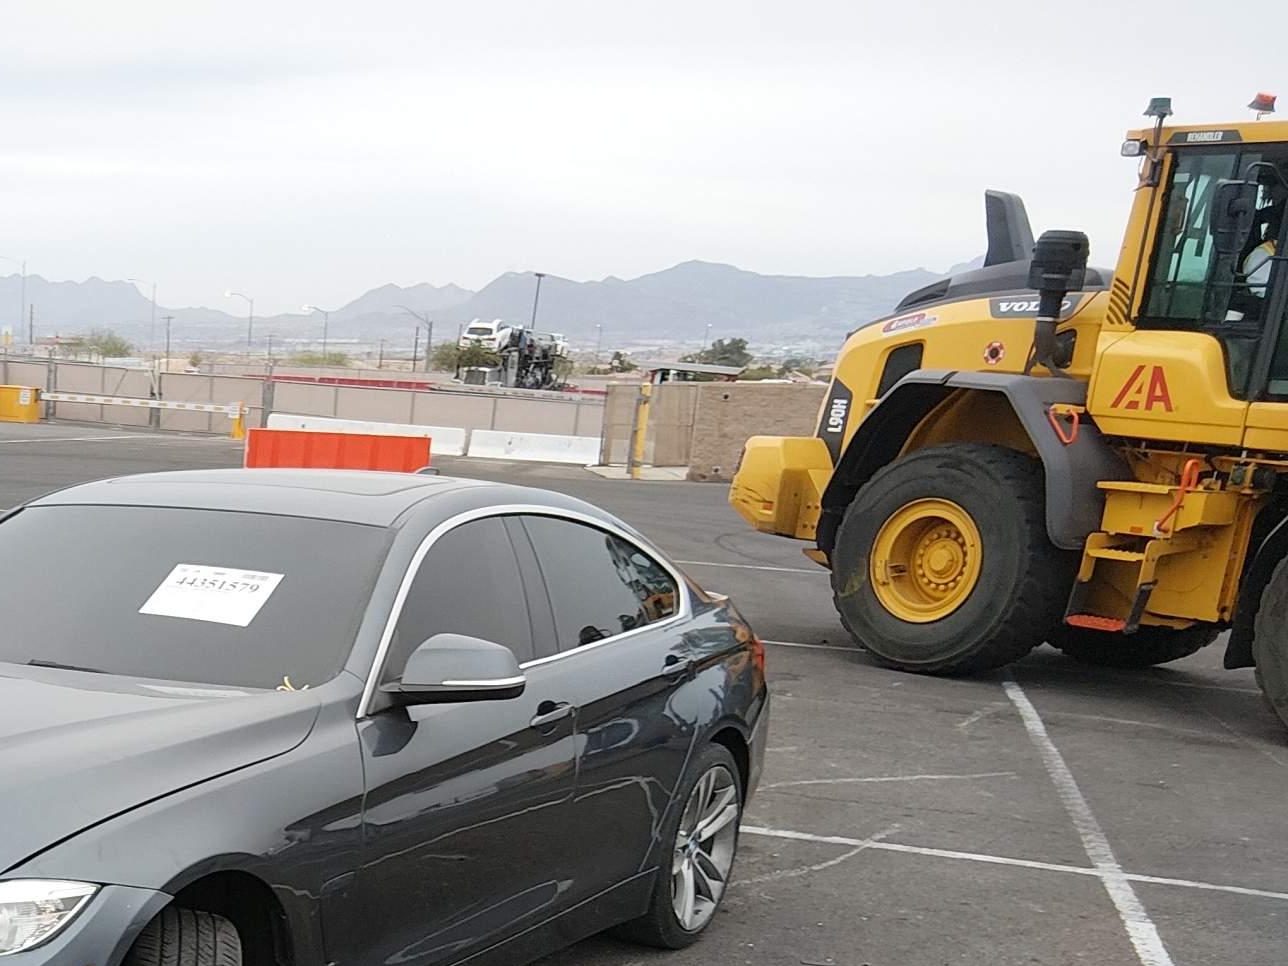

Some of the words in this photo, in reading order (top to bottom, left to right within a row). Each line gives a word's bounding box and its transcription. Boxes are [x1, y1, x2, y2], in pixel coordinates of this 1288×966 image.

[999, 300, 1071, 312] VOLO
[827, 399, 848, 432] L90H
[176, 576, 260, 592] 44351579
